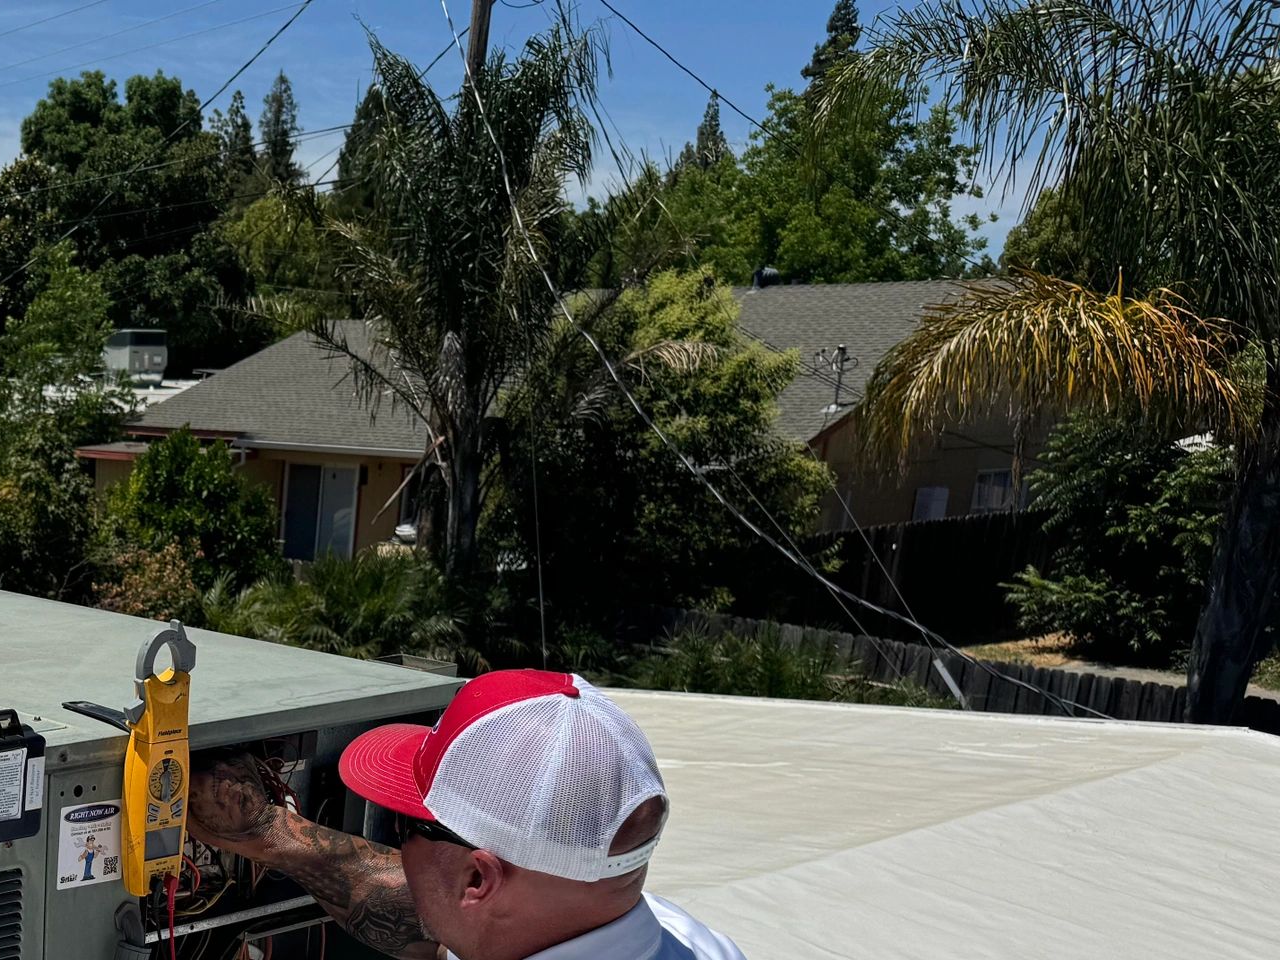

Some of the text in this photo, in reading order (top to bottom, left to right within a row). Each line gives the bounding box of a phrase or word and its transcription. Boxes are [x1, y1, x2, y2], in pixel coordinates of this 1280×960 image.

[70, 807, 115, 820] RIGHT NOW AIR
